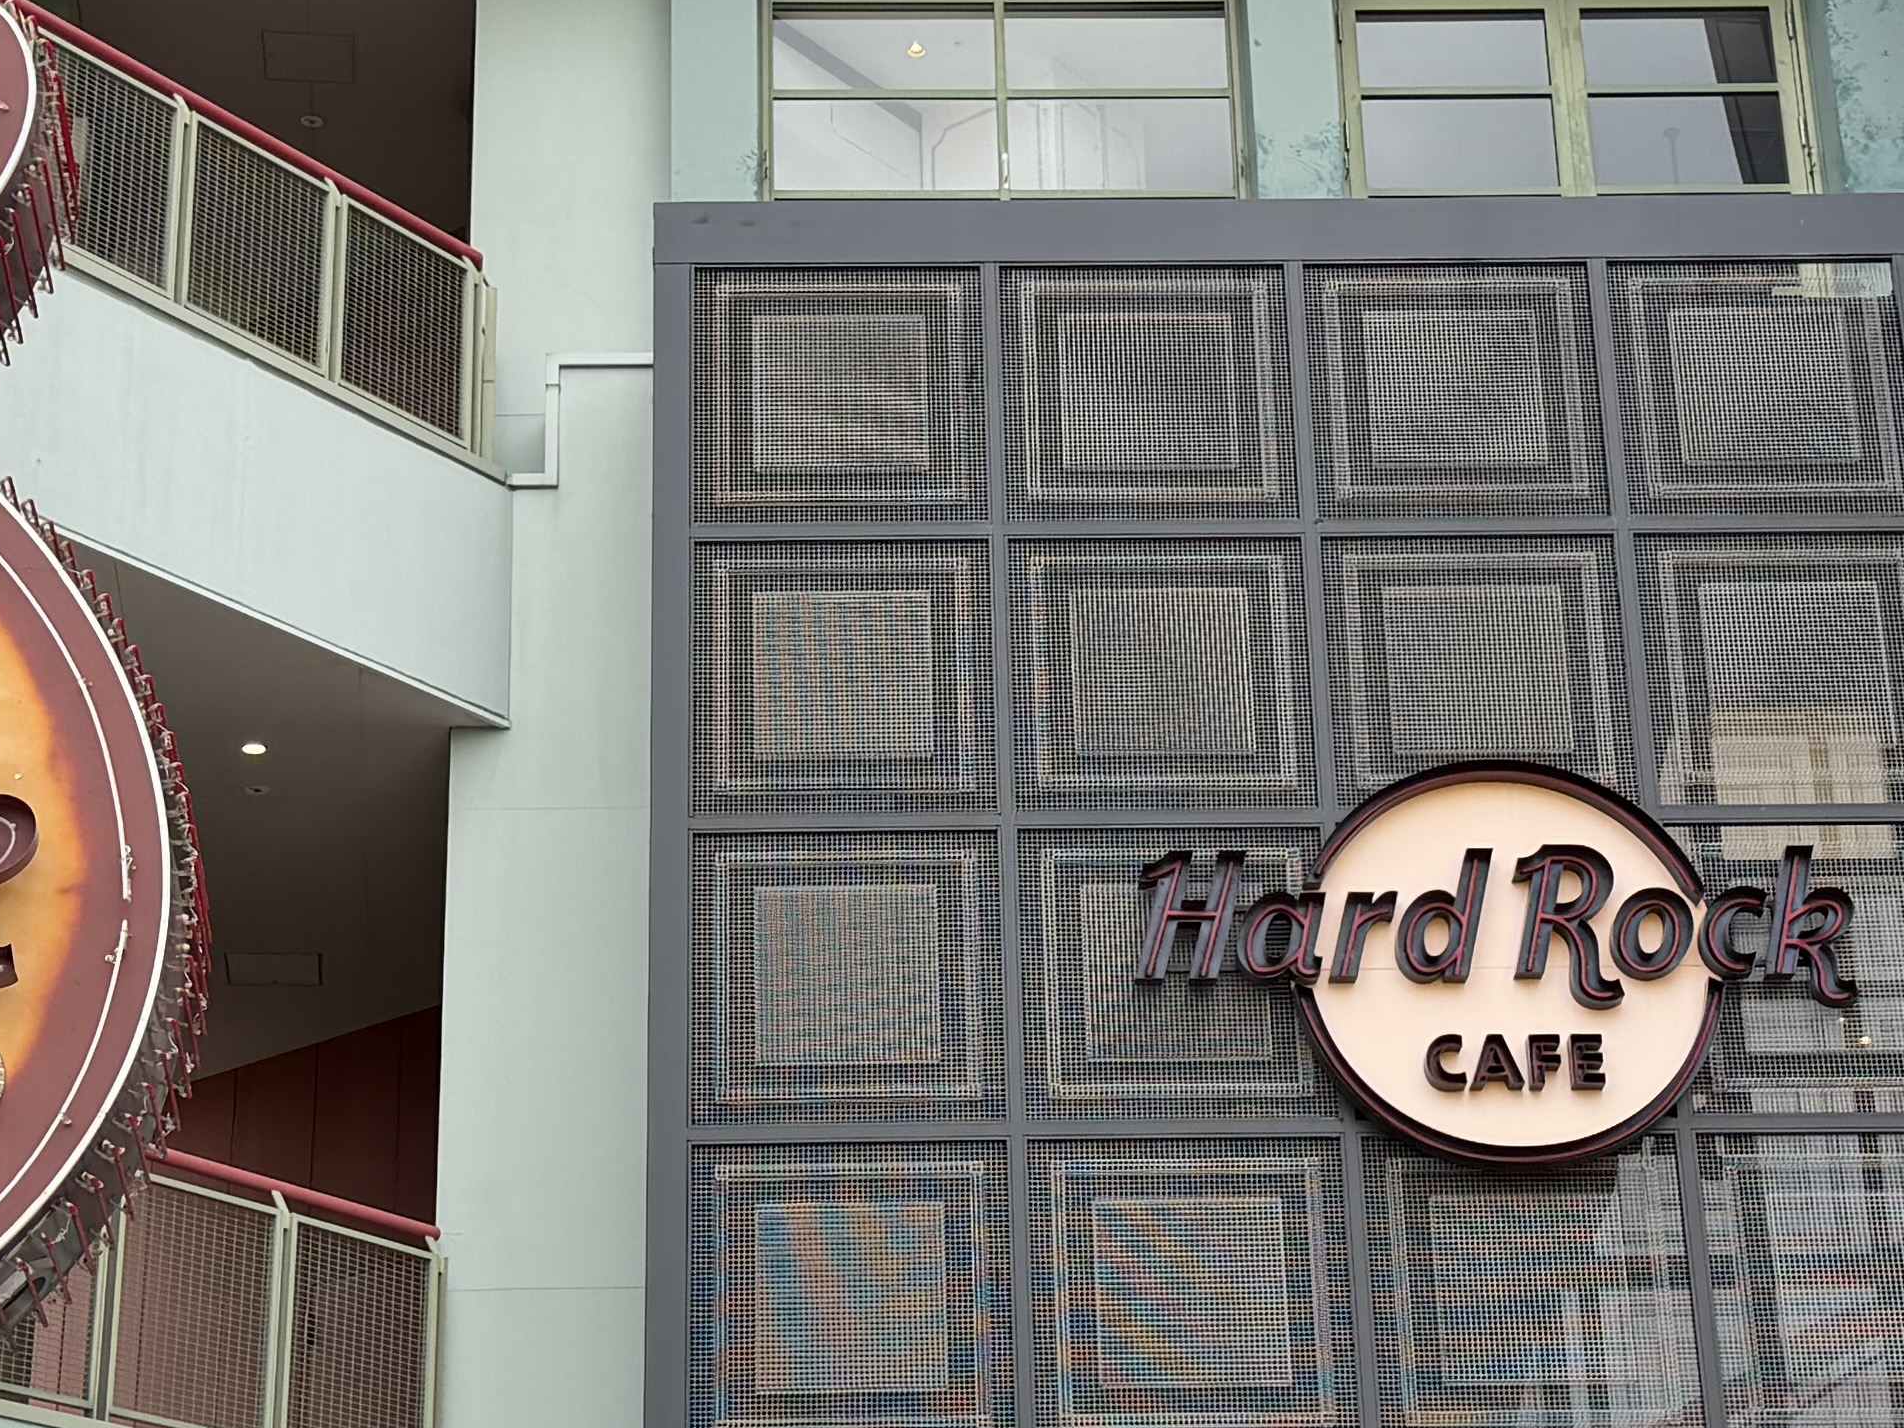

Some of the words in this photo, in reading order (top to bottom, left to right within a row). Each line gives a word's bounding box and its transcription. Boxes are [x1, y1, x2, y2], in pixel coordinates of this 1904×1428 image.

[1134, 847, 1493, 986] Hard
[1512, 843, 1860, 1010] Rock
[1423, 1032, 1607, 1092] CAFE
